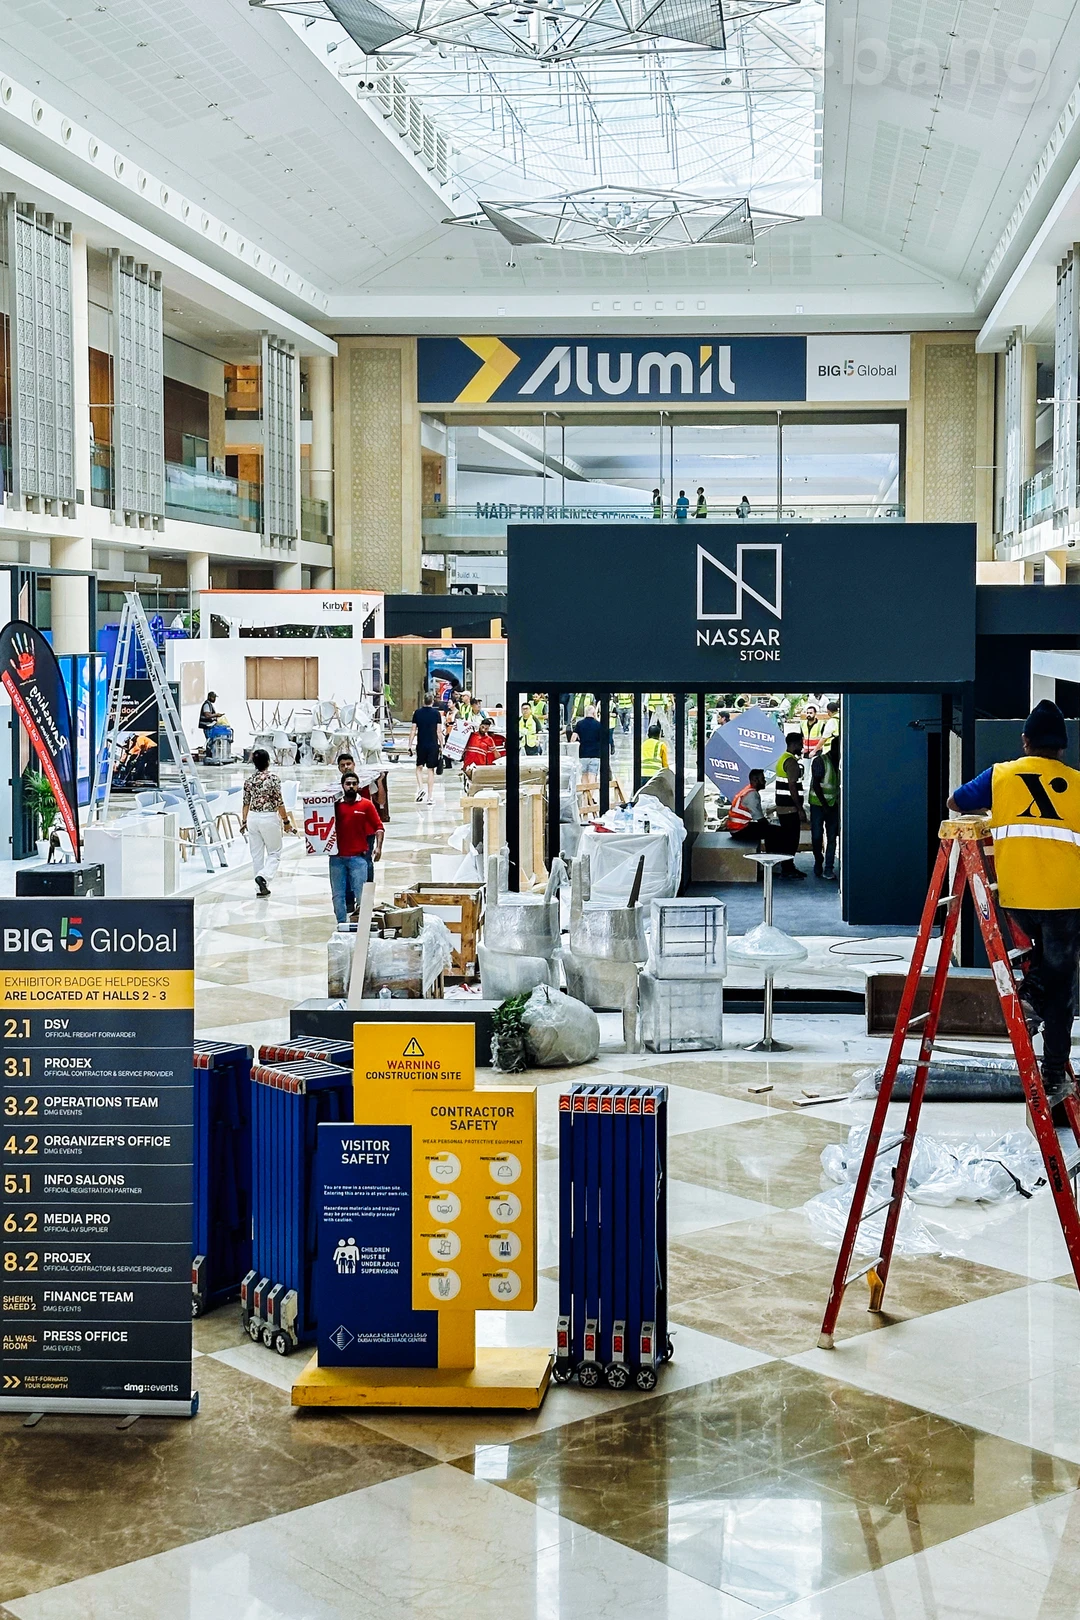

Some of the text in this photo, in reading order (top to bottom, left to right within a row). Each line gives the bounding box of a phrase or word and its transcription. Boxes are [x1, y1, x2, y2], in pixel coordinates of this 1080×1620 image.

[518, 345, 736, 396] Alumil
[818, 360, 896, 376] BIG 5 Global
[696, 629, 780, 646] NASSAR
[740, 650, 780, 660] STONE
[738, 727, 774, 742] TOSTEM
[709, 758, 738, 771] TOSTEM
[4, 917, 176, 952] BIG 5 Global
[4, 977, 170, 986] EXHIBITOR BADGE HELPDESKS
[4, 991, 28, 1001] ARE
[30, 991, 82, 1001] LOCATED
[86, 991, 99, 1001] AT
[103, 991, 139, 1001] HALLS
[142, 991, 149, 1001] 2
[160, 991, 166, 1001] 3
[4, 1019, 30, 1038] 2.1
[44, 1020, 69, 1029] DSV
[4, 1058, 30, 1076] 3.1
[44, 1058, 92, 1068] PROJEX
[387, 1060, 440, 1070] WARNING
[366, 1072, 461, 1080] CONSTRUCTION SITE
[4, 1096, 38, 1116] 3.2
[44, 1097, 158, 1107] OPERATIONS TEAM
[430, 1106, 514, 1118] CONTRACTOR
[450, 1120, 498, 1130] SAFETY
[4, 1136, 38, 1154] 4.2
[44, 1136, 170, 1146] ORGANIZER'S OFFICE
[341, 1140, 390, 1150] VISITOR
[342, 1154, 390, 1164] SAFETY
[4, 1174, 31, 1194] 5.1
[44, 1175, 124, 1185] INFO SALONS
[4, 1213, 38, 1232] 6.2
[44, 1214, 110, 1224] MEDIA PRO
[4, 1252, 38, 1272] 8.2
[44, 1253, 91, 1263] PROJEX
[43, 1292, 134, 1302] FINANCE TEAM
[43, 1331, 128, 1342] PRESS OFFICE
